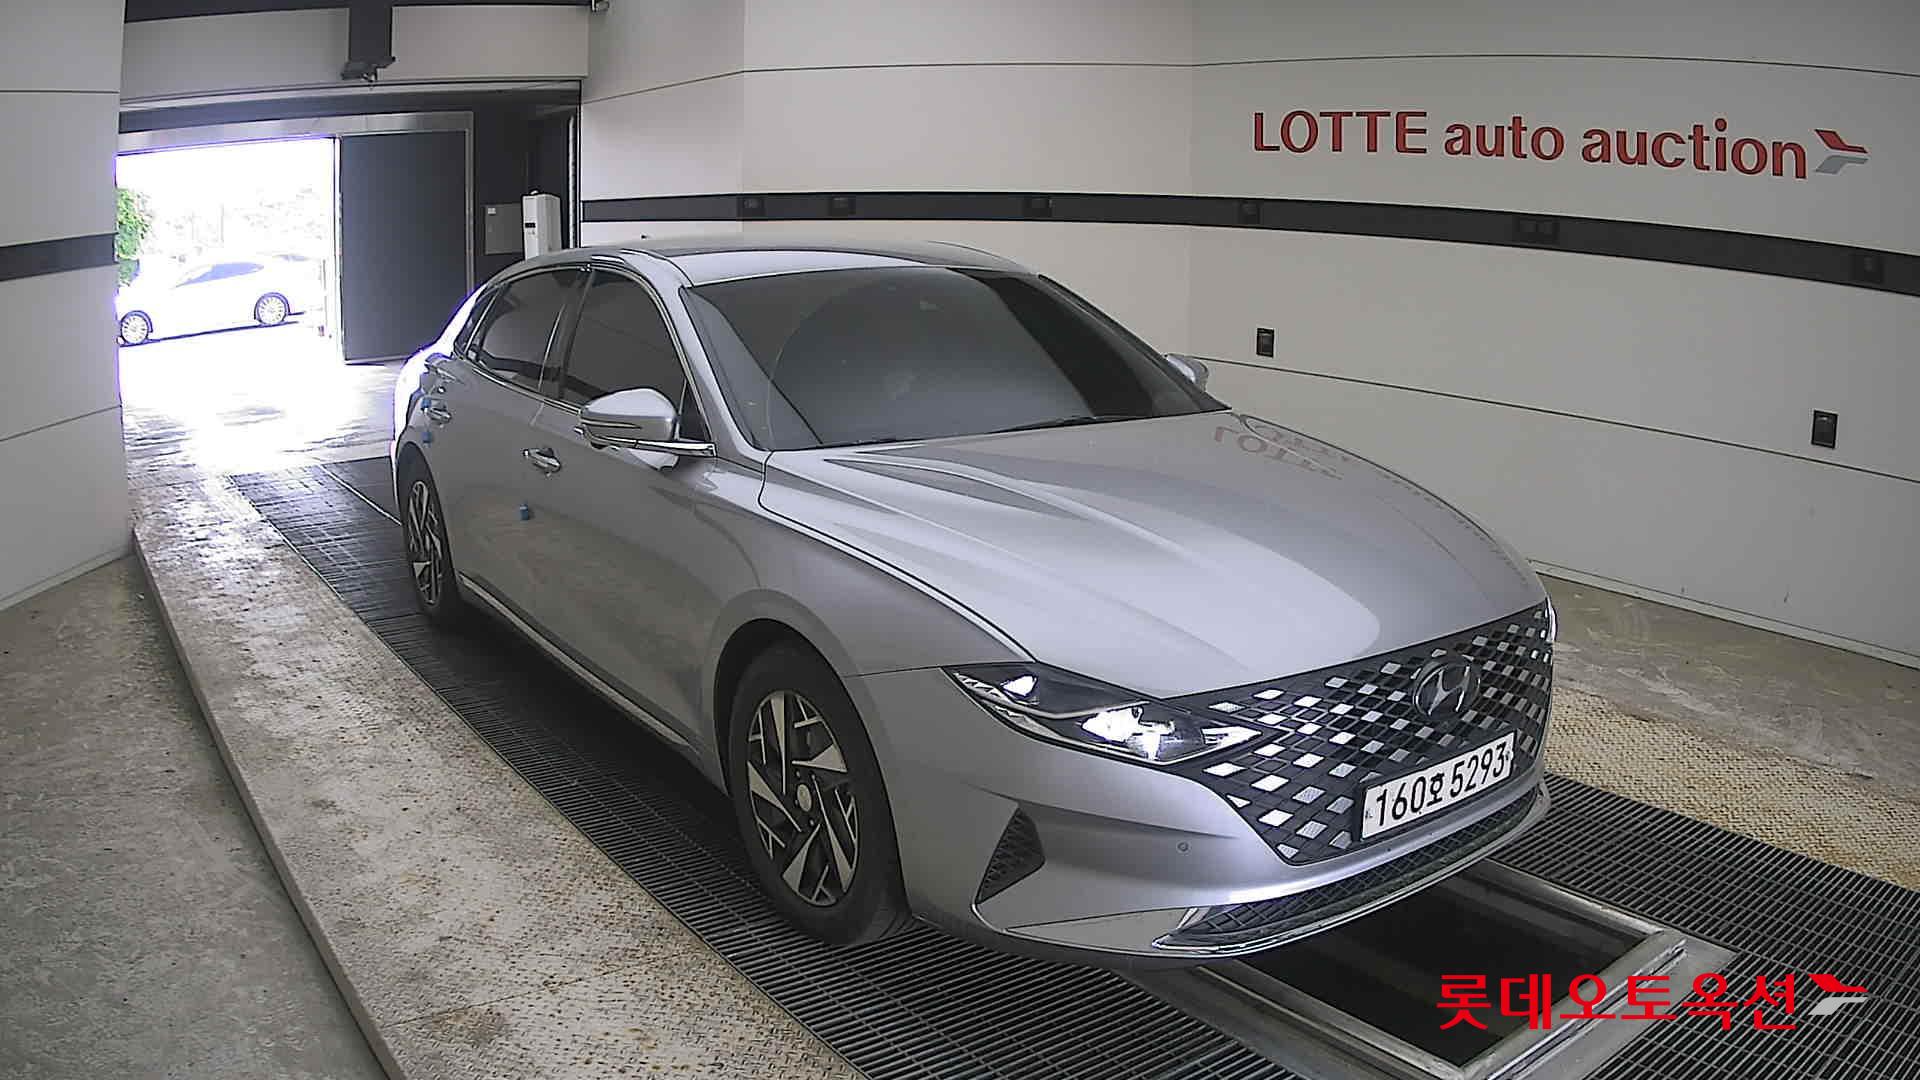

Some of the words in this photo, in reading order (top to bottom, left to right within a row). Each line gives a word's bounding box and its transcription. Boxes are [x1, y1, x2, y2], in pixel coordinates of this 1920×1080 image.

[1254, 110, 1427, 154] LOTTE
[1445, 115, 1565, 160] auto
[1581, 118, 1807, 179] auction
[1376, 773, 1445, 826] 160호
[1450, 742, 1506, 798] 5293
